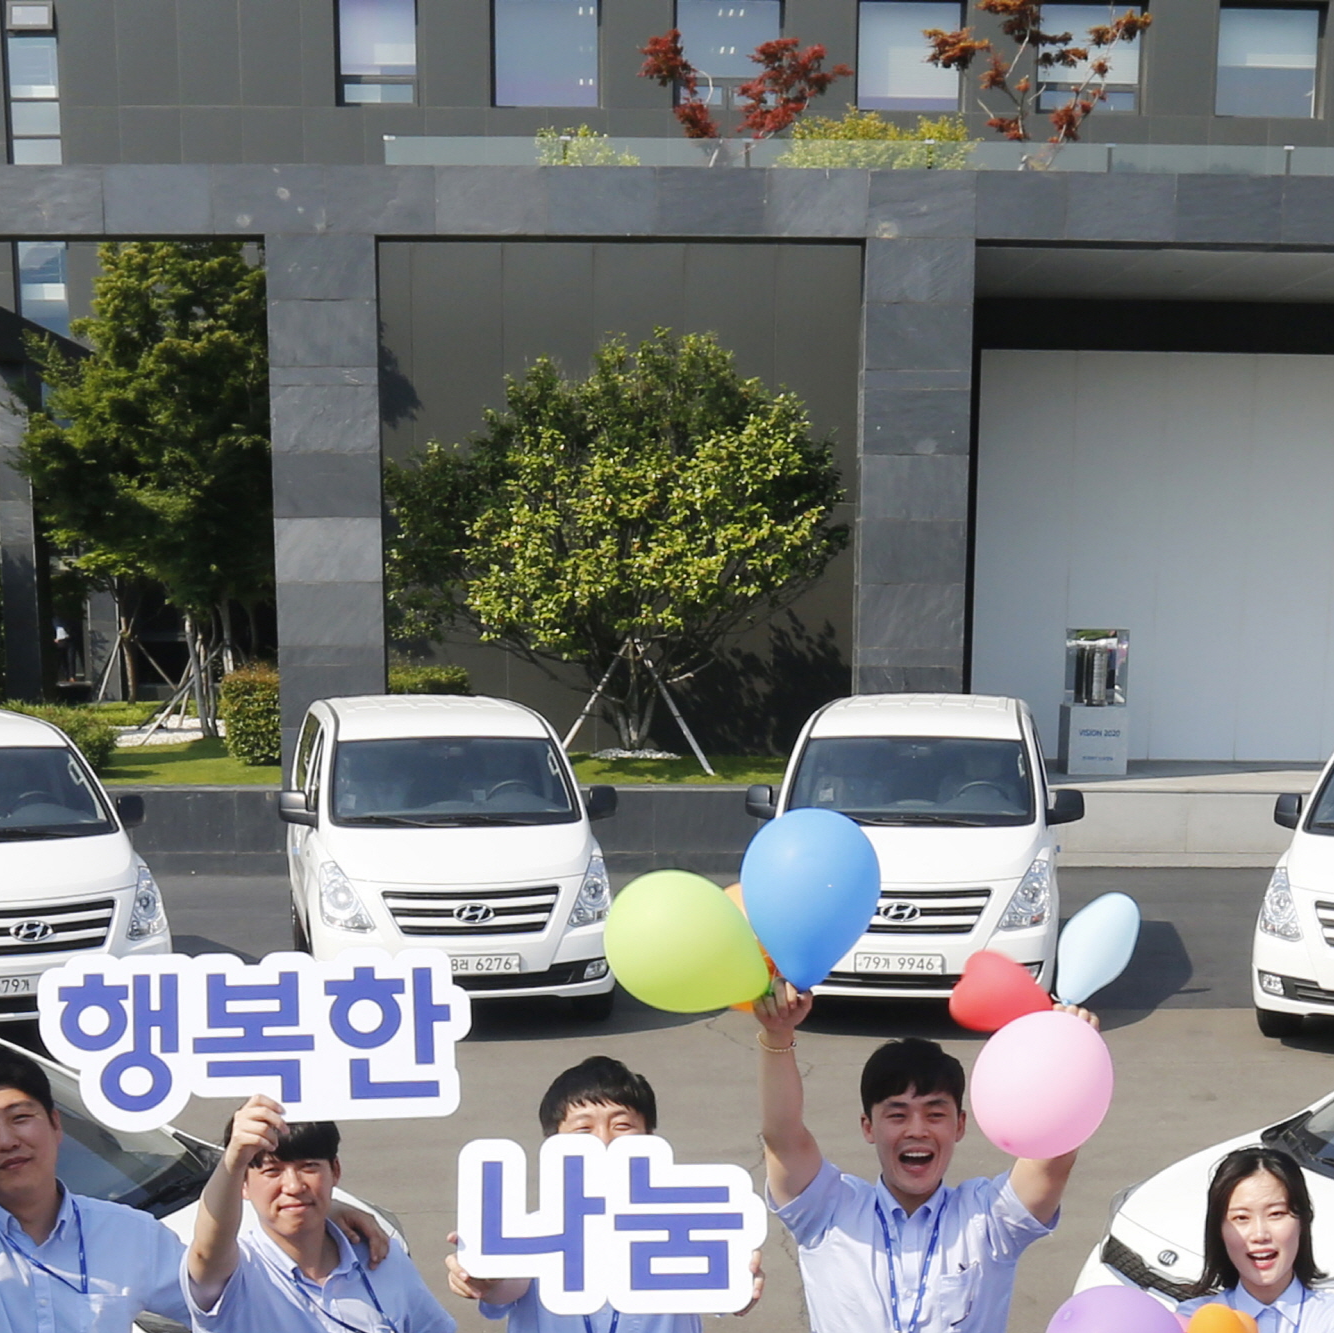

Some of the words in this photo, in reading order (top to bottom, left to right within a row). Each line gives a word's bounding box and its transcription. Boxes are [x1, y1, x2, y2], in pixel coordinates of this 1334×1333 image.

[1079, 729, 1102, 737] VISION
[450, 958, 469, 972] 8러
[475, 957, 513, 972] 6276
[897, 957, 934, 971] 9946
[58, 967, 451, 1112] 행복한
[481, 1155, 745, 1291] 나눔
